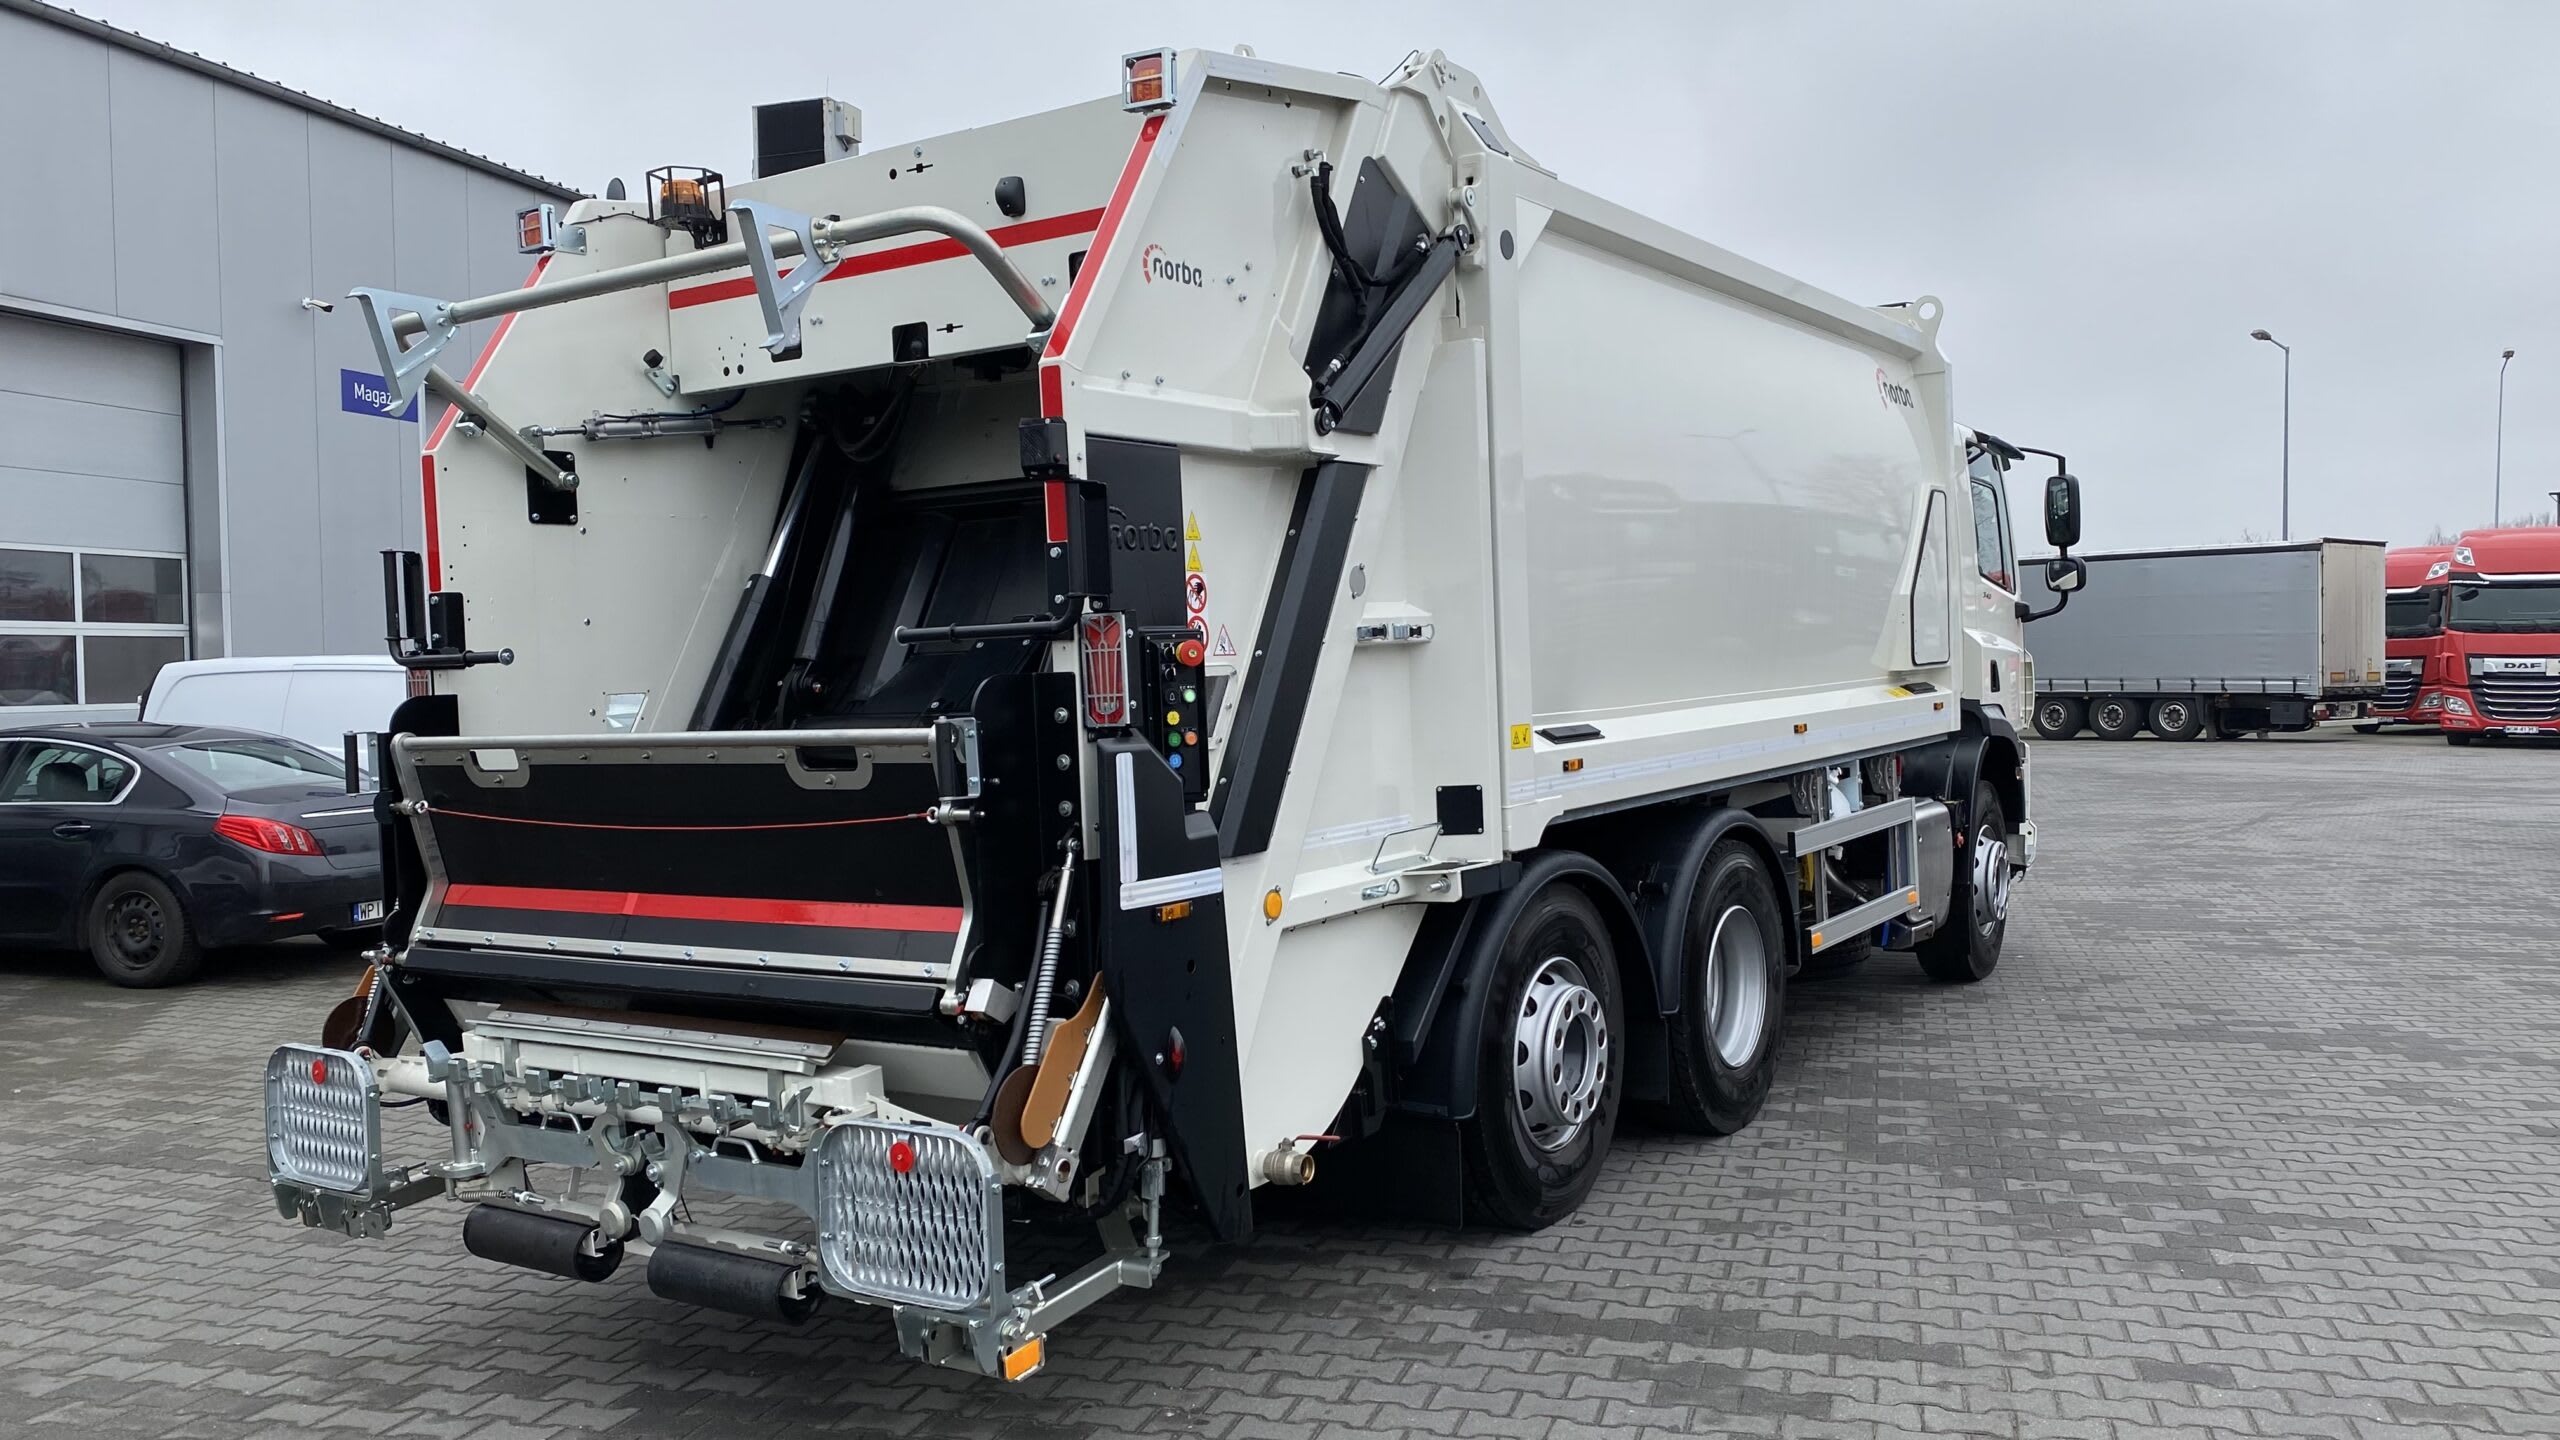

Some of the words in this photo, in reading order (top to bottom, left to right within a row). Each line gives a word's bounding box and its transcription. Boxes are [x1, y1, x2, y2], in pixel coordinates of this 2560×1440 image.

[1152, 257, 1203, 288] norba
[354, 382, 392, 408] Magaz
[1882, 381, 1914, 409] norba
